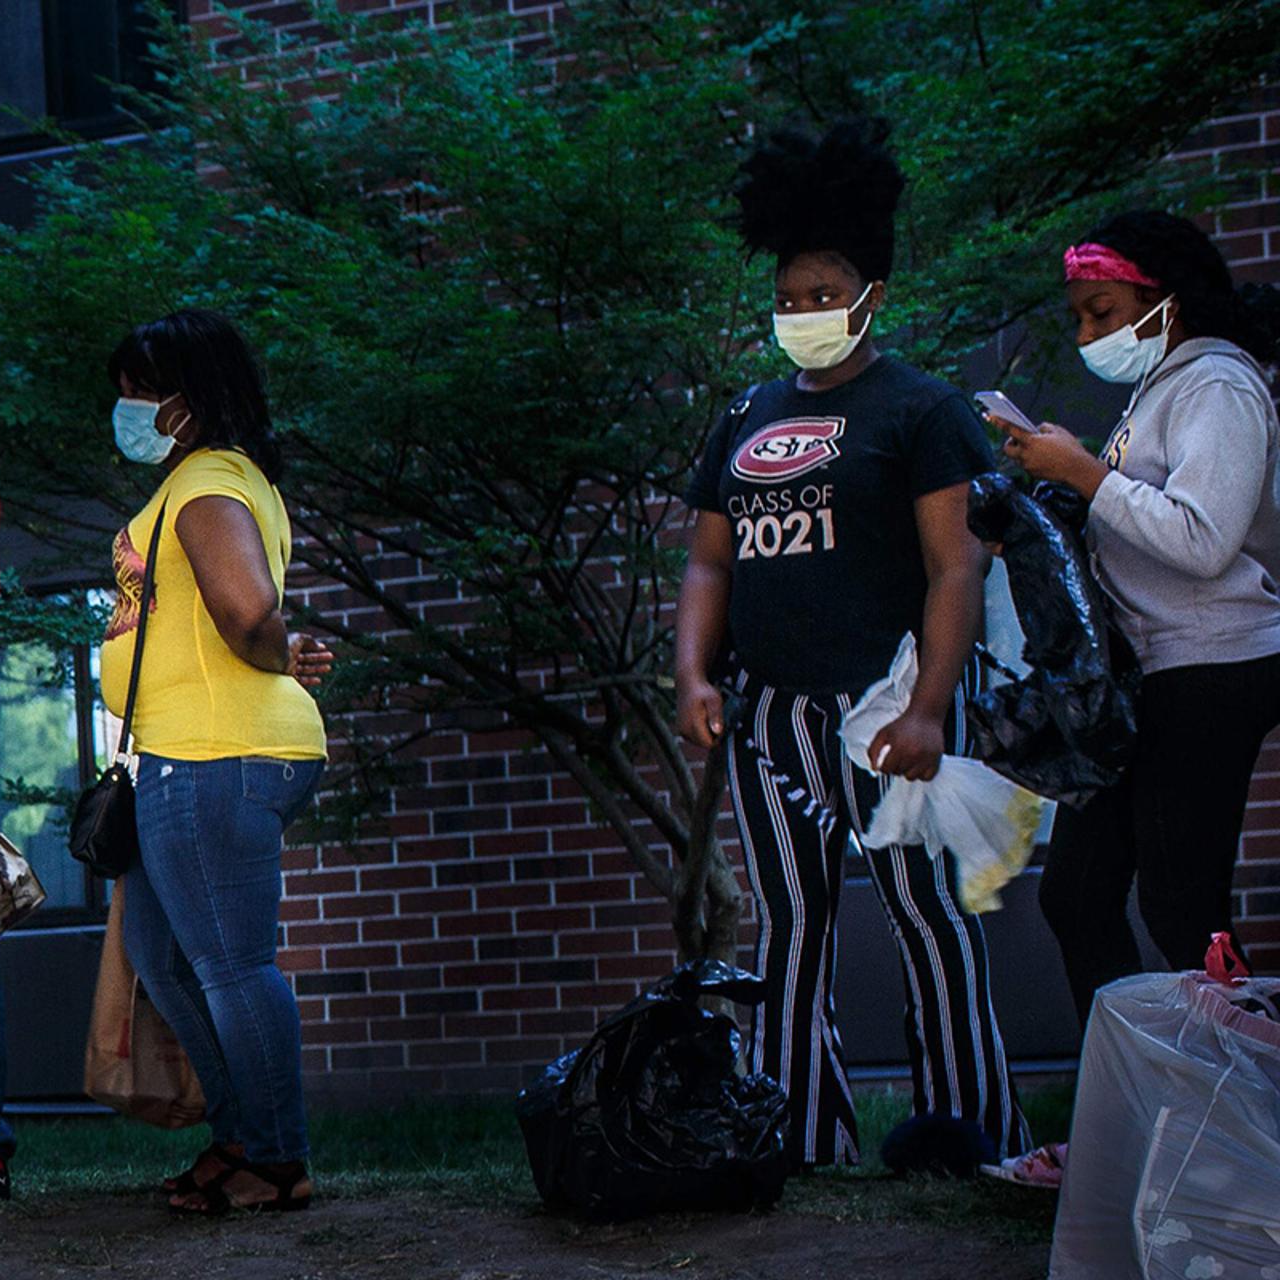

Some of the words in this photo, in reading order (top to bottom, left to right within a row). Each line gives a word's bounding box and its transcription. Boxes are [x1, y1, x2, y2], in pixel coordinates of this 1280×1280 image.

[727, 489, 793, 519] CLASS
[799, 484, 834, 508] OF
[736, 508, 836, 561] 2021
